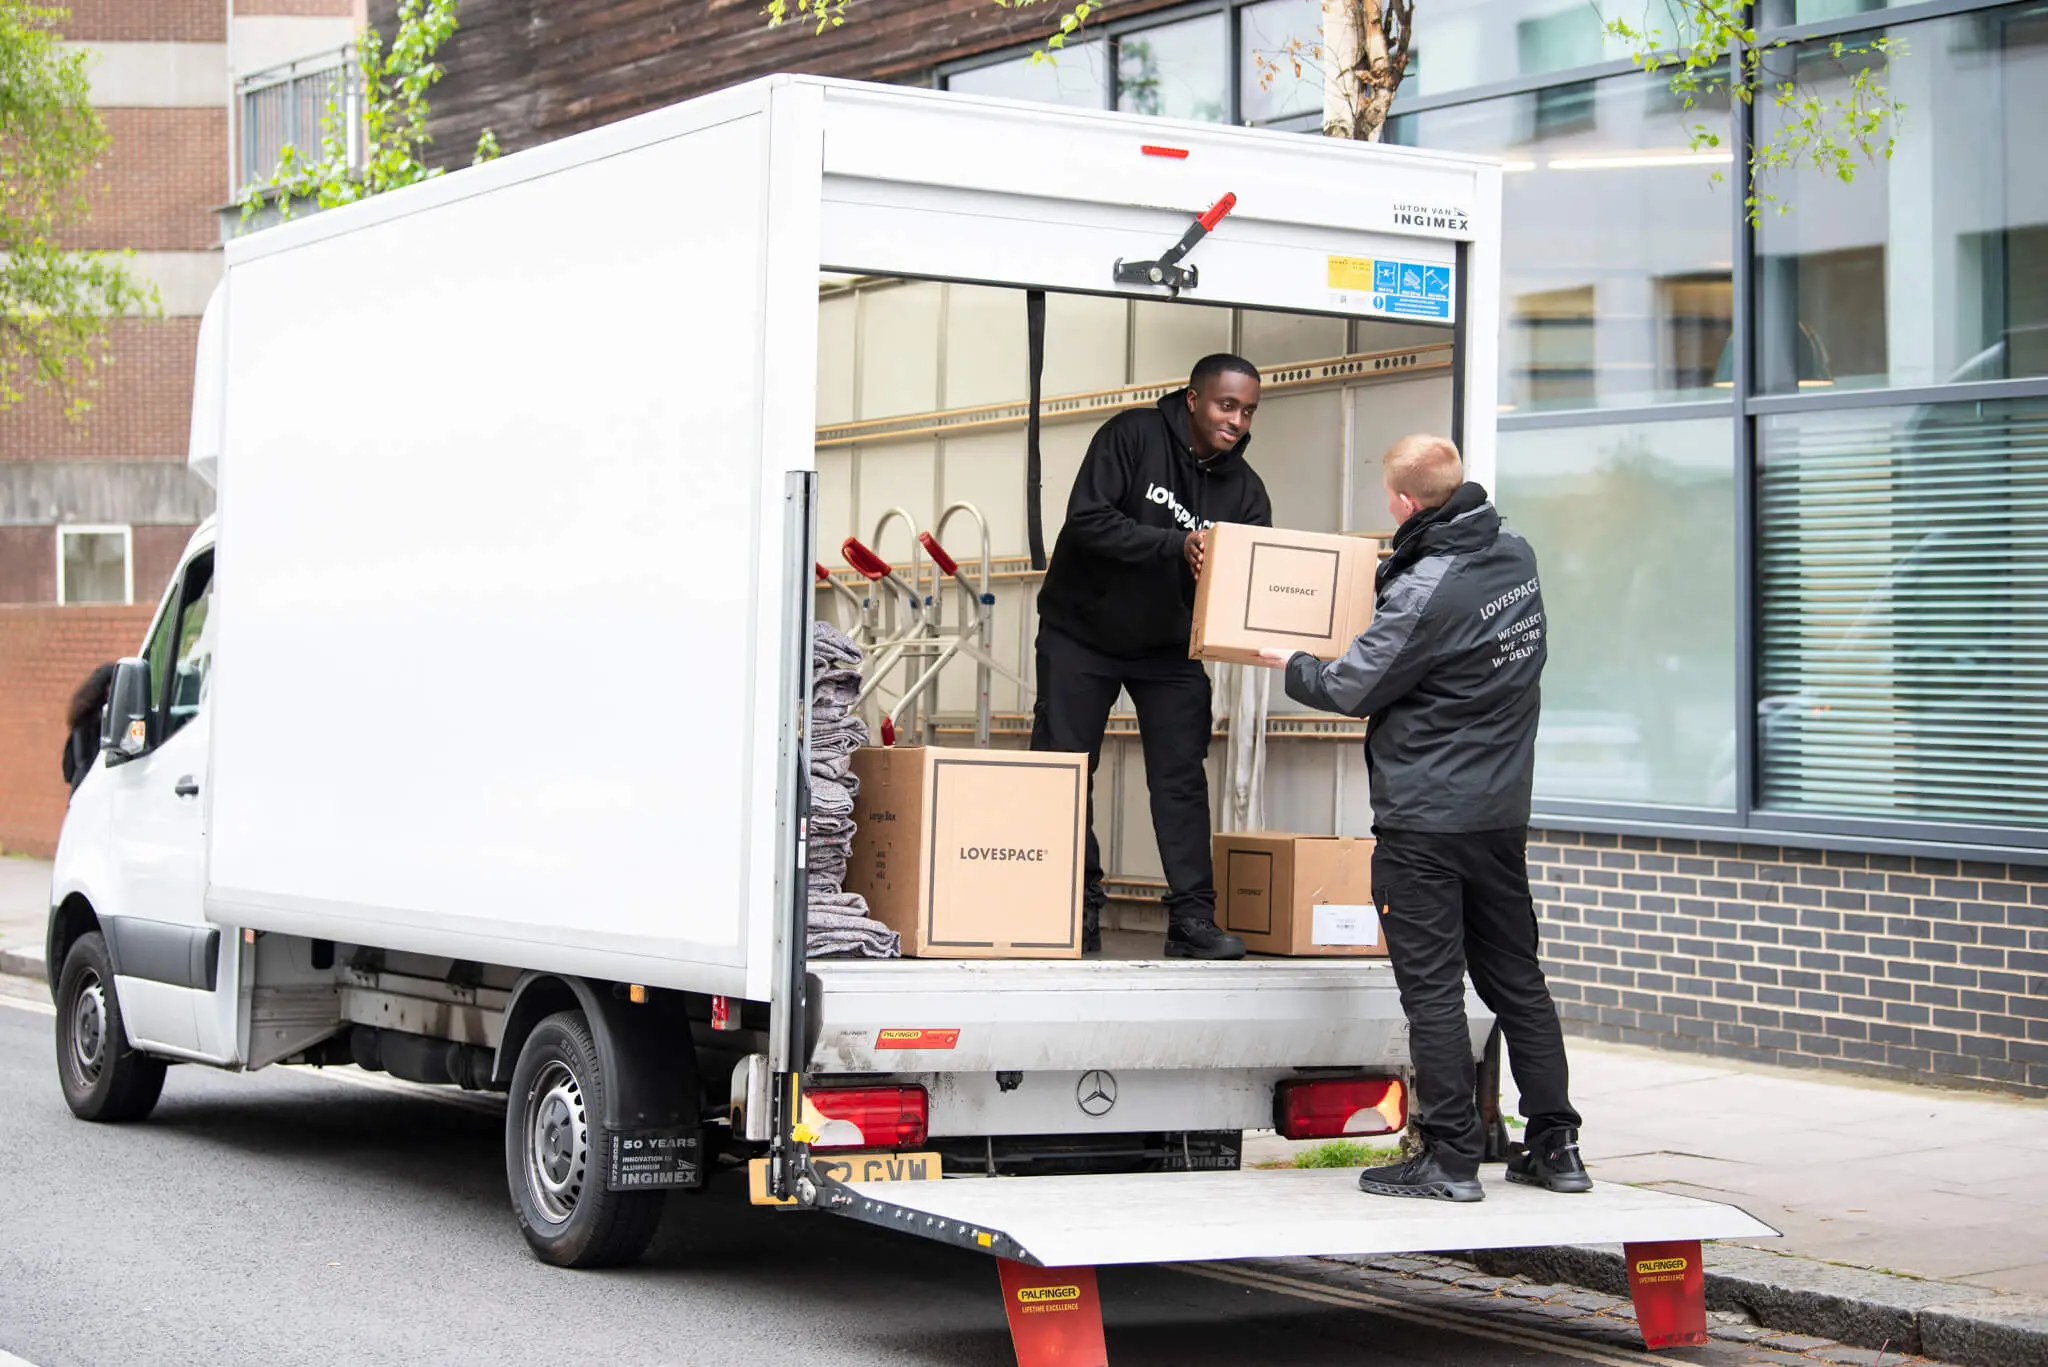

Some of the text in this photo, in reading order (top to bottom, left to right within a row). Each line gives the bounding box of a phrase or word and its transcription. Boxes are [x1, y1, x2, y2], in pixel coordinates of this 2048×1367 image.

[1393, 204, 1451, 216] LUTON VAN
[1394, 213, 1469, 231] INGIMEX
[1269, 584, 1316, 596] LOVESPACE
[1480, 577, 1539, 620] LOVESPACE
[960, 847, 1044, 862] LOVESPACE
[623, 1138, 697, 1149] 50 YEARS
[622, 1171, 697, 1184] INGIMEX
[1639, 1260, 1684, 1271] PALFINGER
[1021, 1288, 1077, 1299] PALFINGER
[1046, 1303, 1079, 1312] EXCELLENCE
